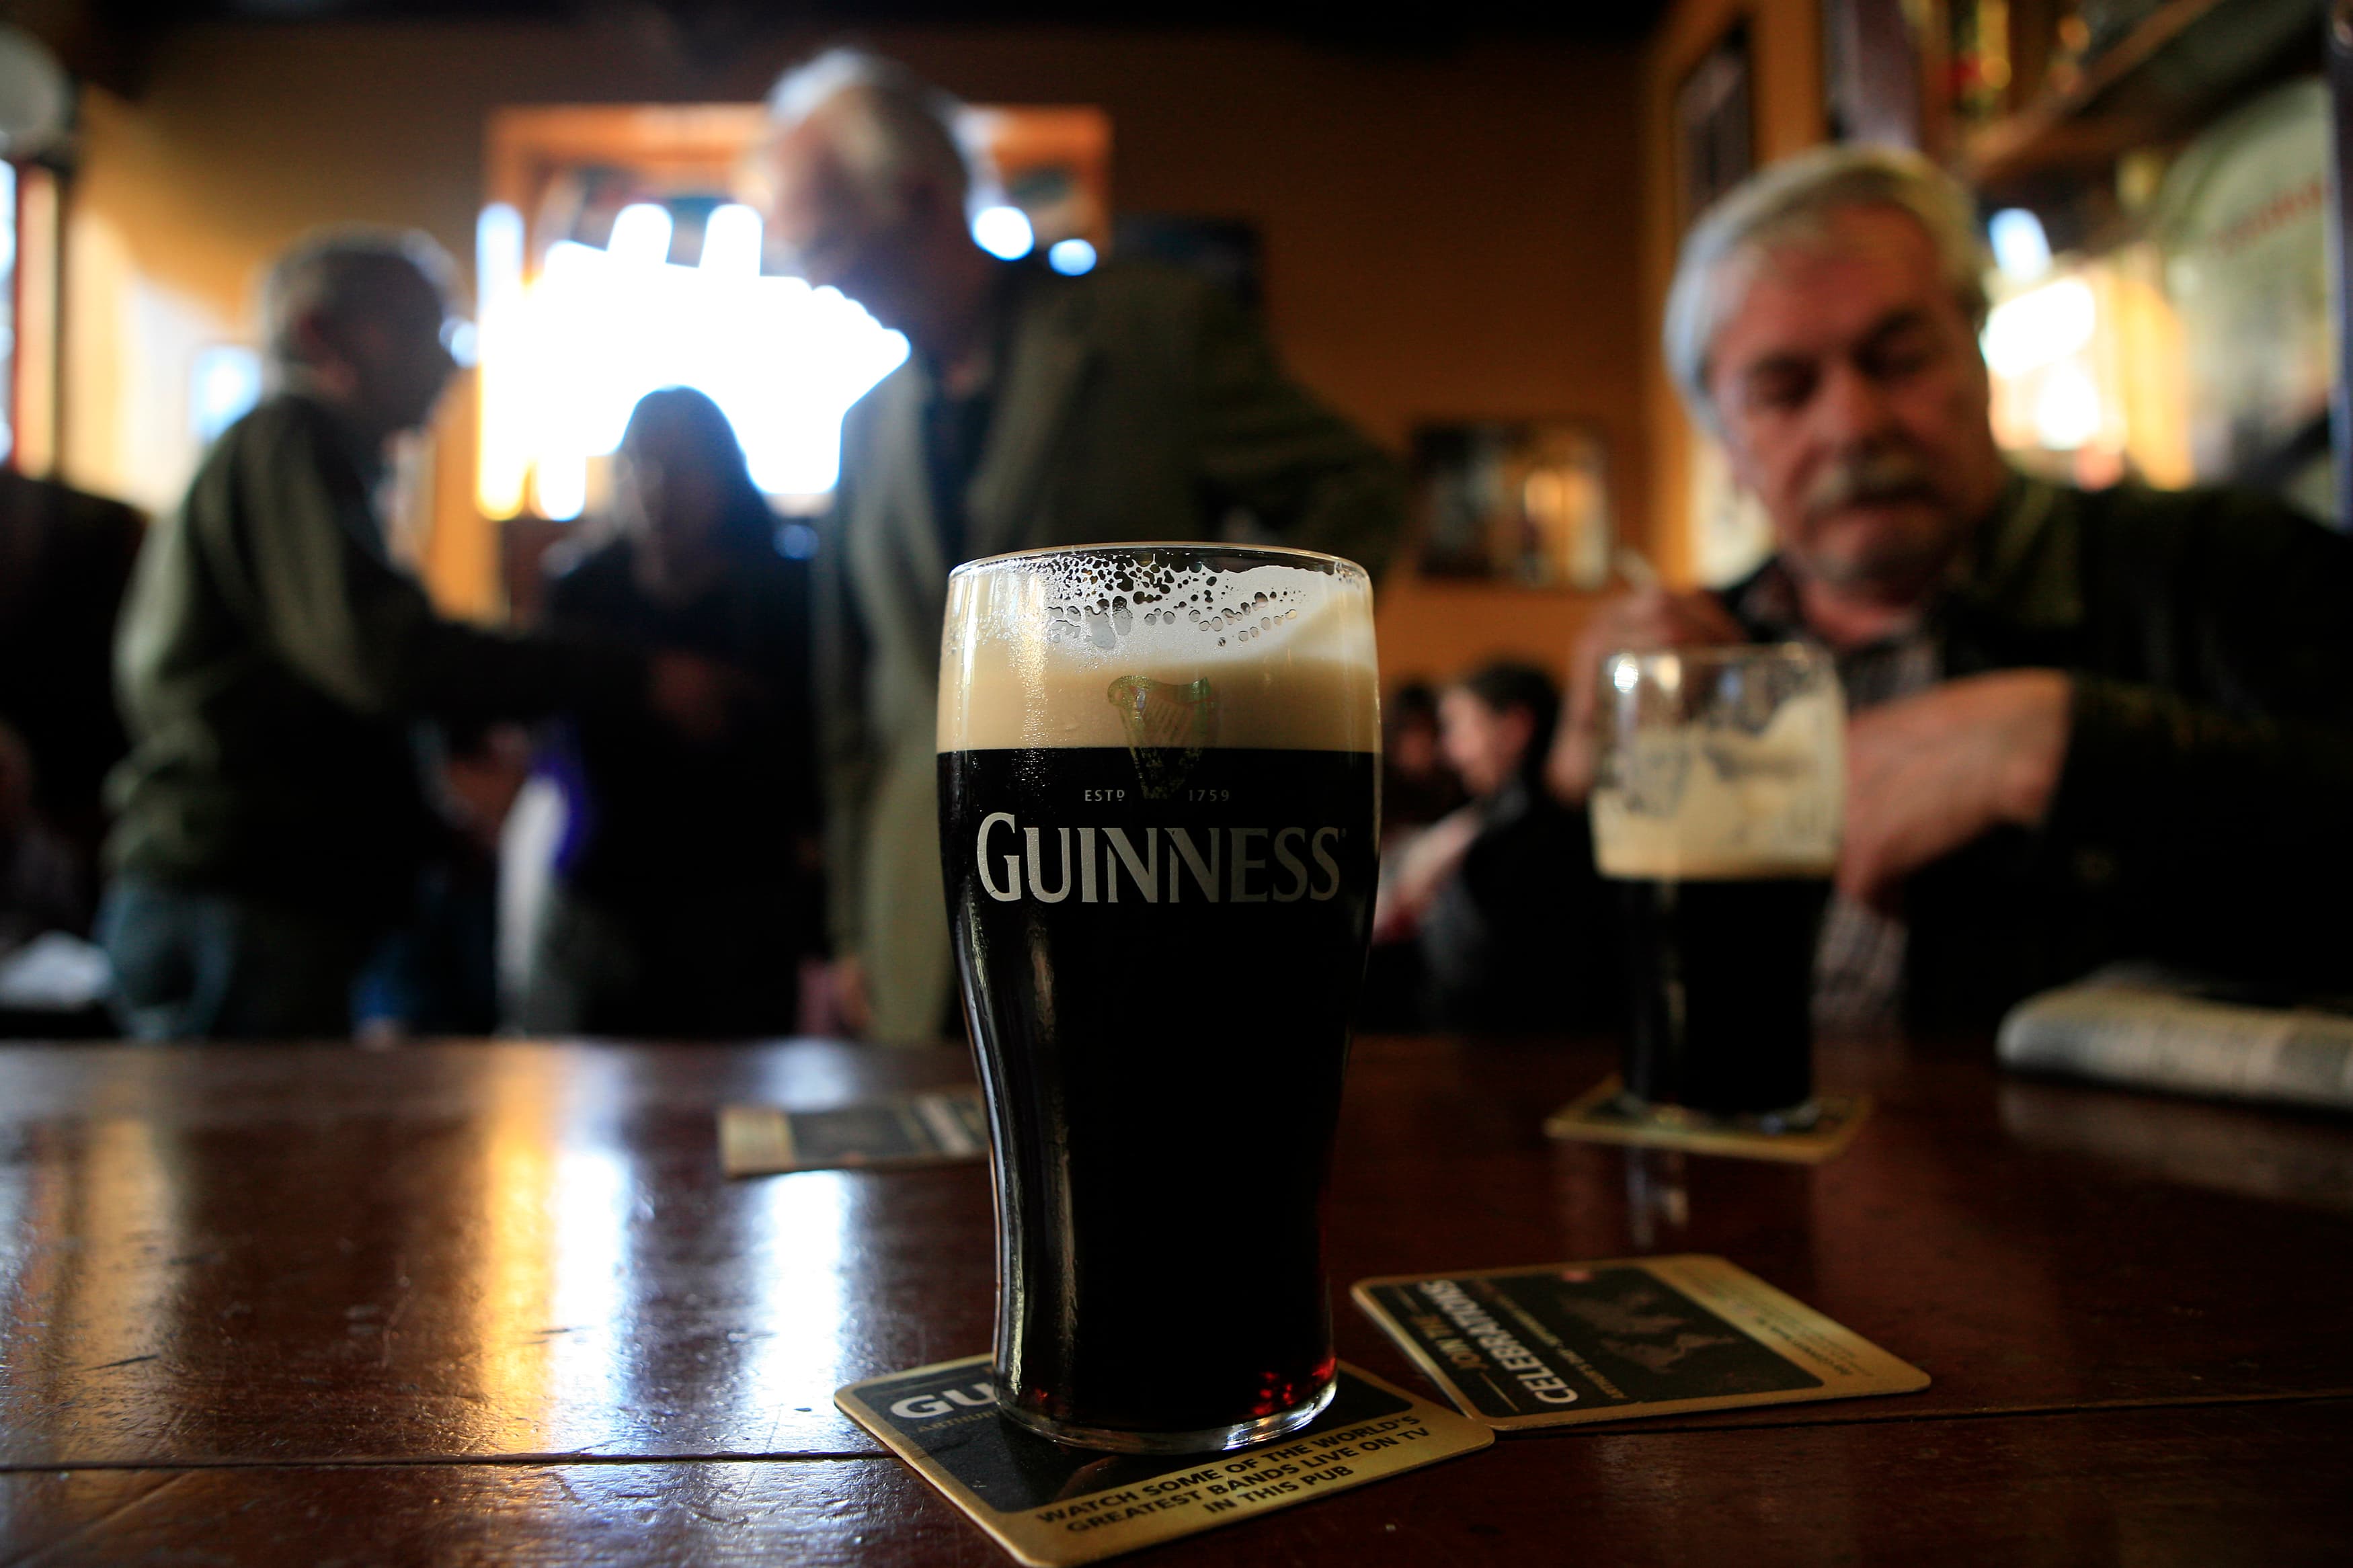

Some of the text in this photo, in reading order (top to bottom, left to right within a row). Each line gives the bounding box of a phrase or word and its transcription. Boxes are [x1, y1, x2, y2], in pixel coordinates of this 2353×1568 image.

[1189, 789, 1230, 802] 1759
[976, 811, 1340, 904] GUINNESS
[1417, 1278, 1579, 1405] CELEBRATIONS
[1036, 1415, 1422, 1524] WATCH SOME OF THE WORLD'S
[1066, 1426, 1431, 1532] GREATEST BANDS LIVE ON TV
[1203, 1465, 1354, 1513] IN THIS PUB
